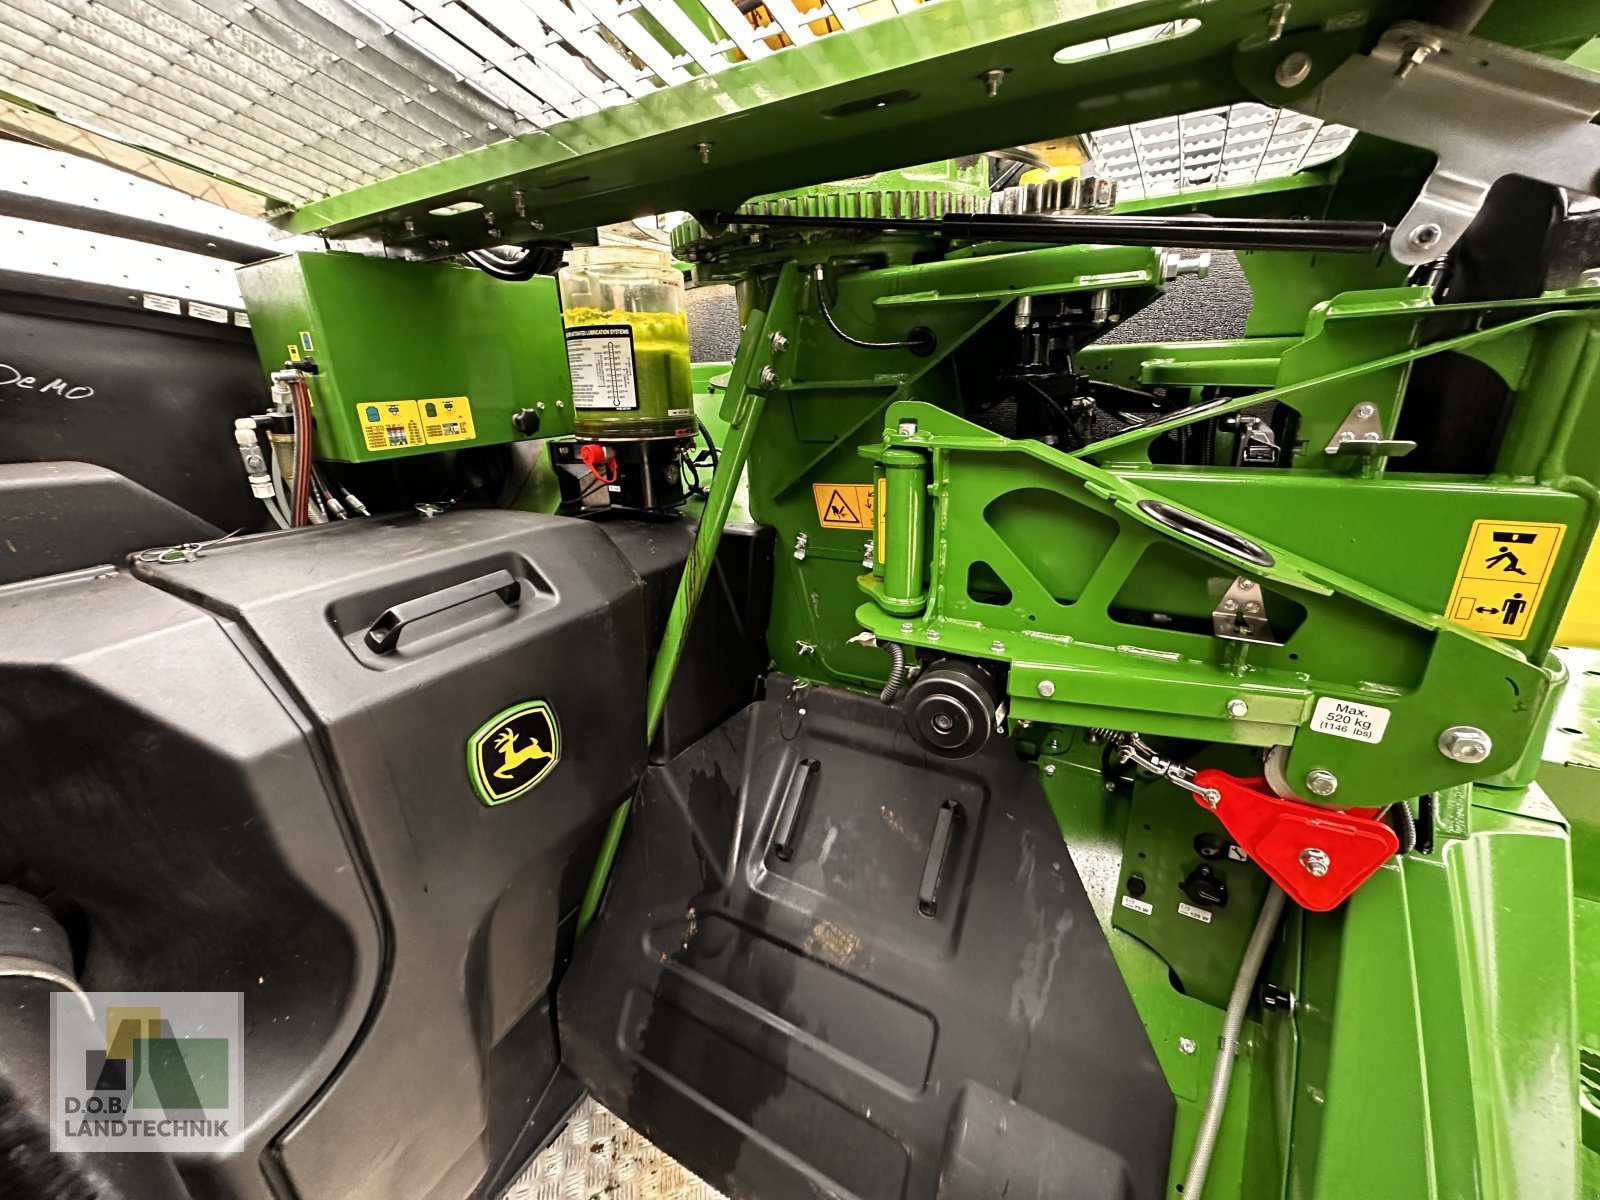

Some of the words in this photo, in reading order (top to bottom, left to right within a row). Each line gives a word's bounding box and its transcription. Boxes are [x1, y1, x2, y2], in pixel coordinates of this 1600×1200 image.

[1336, 703, 1368, 718] Max.
[1320, 721, 1348, 733] (1146
[1353, 728, 1372, 738] lbs)
[1326, 712, 1351, 724] 520
[1354, 717, 1372, 730] kg
